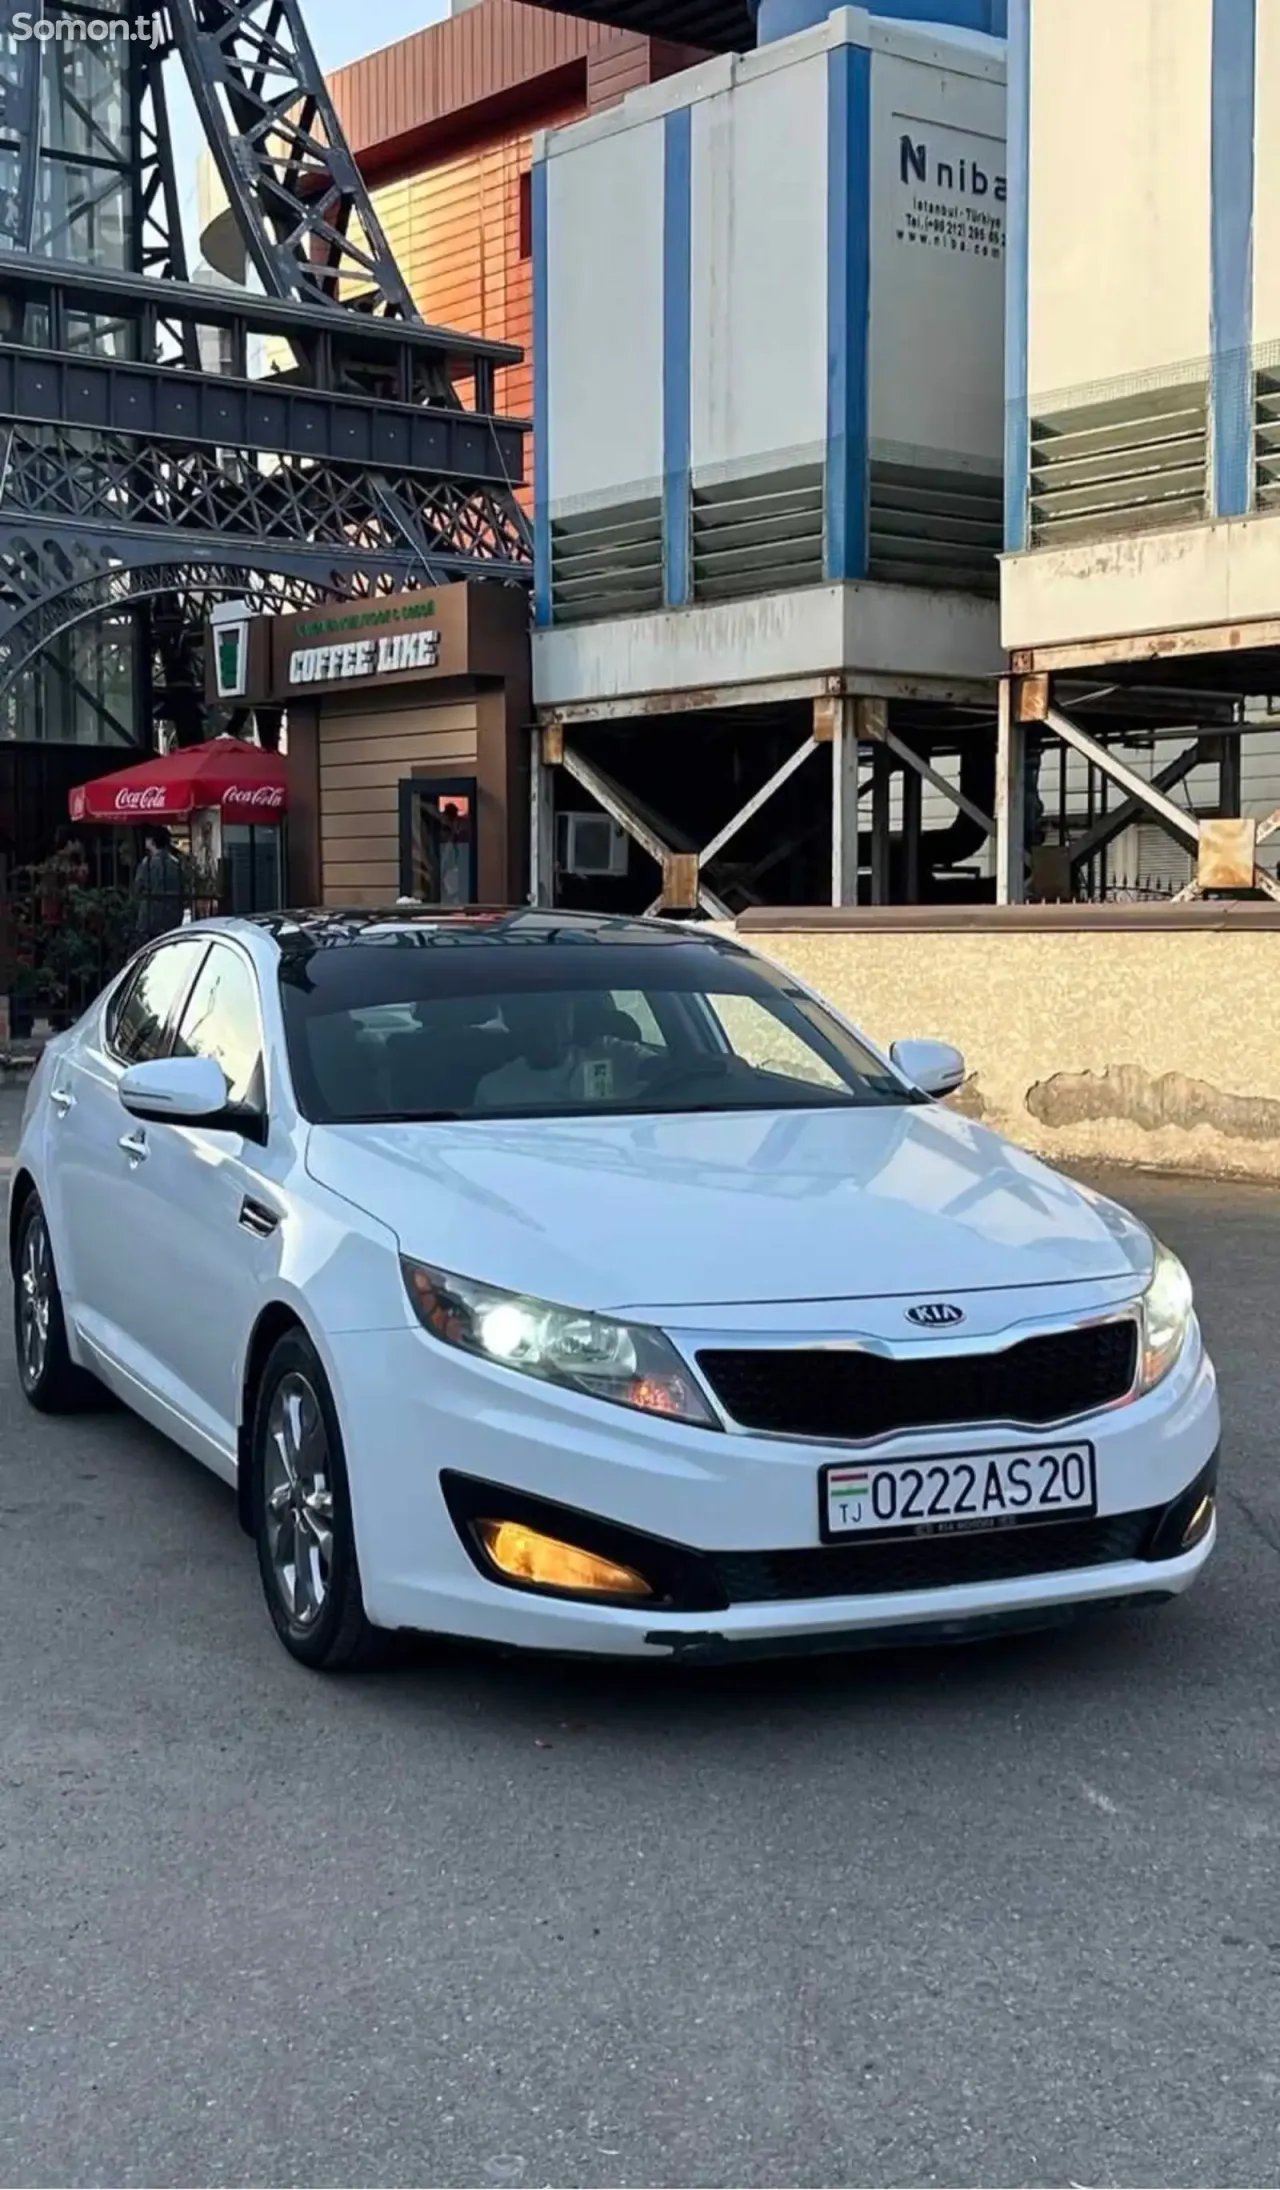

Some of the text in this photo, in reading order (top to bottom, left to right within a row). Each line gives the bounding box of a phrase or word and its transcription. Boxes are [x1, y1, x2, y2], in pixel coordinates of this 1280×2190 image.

[289, 630, 439, 684] COFFEE LIKE
[914, 1305, 960, 1321] KIA
[839, 1503, 862, 1524] TJ
